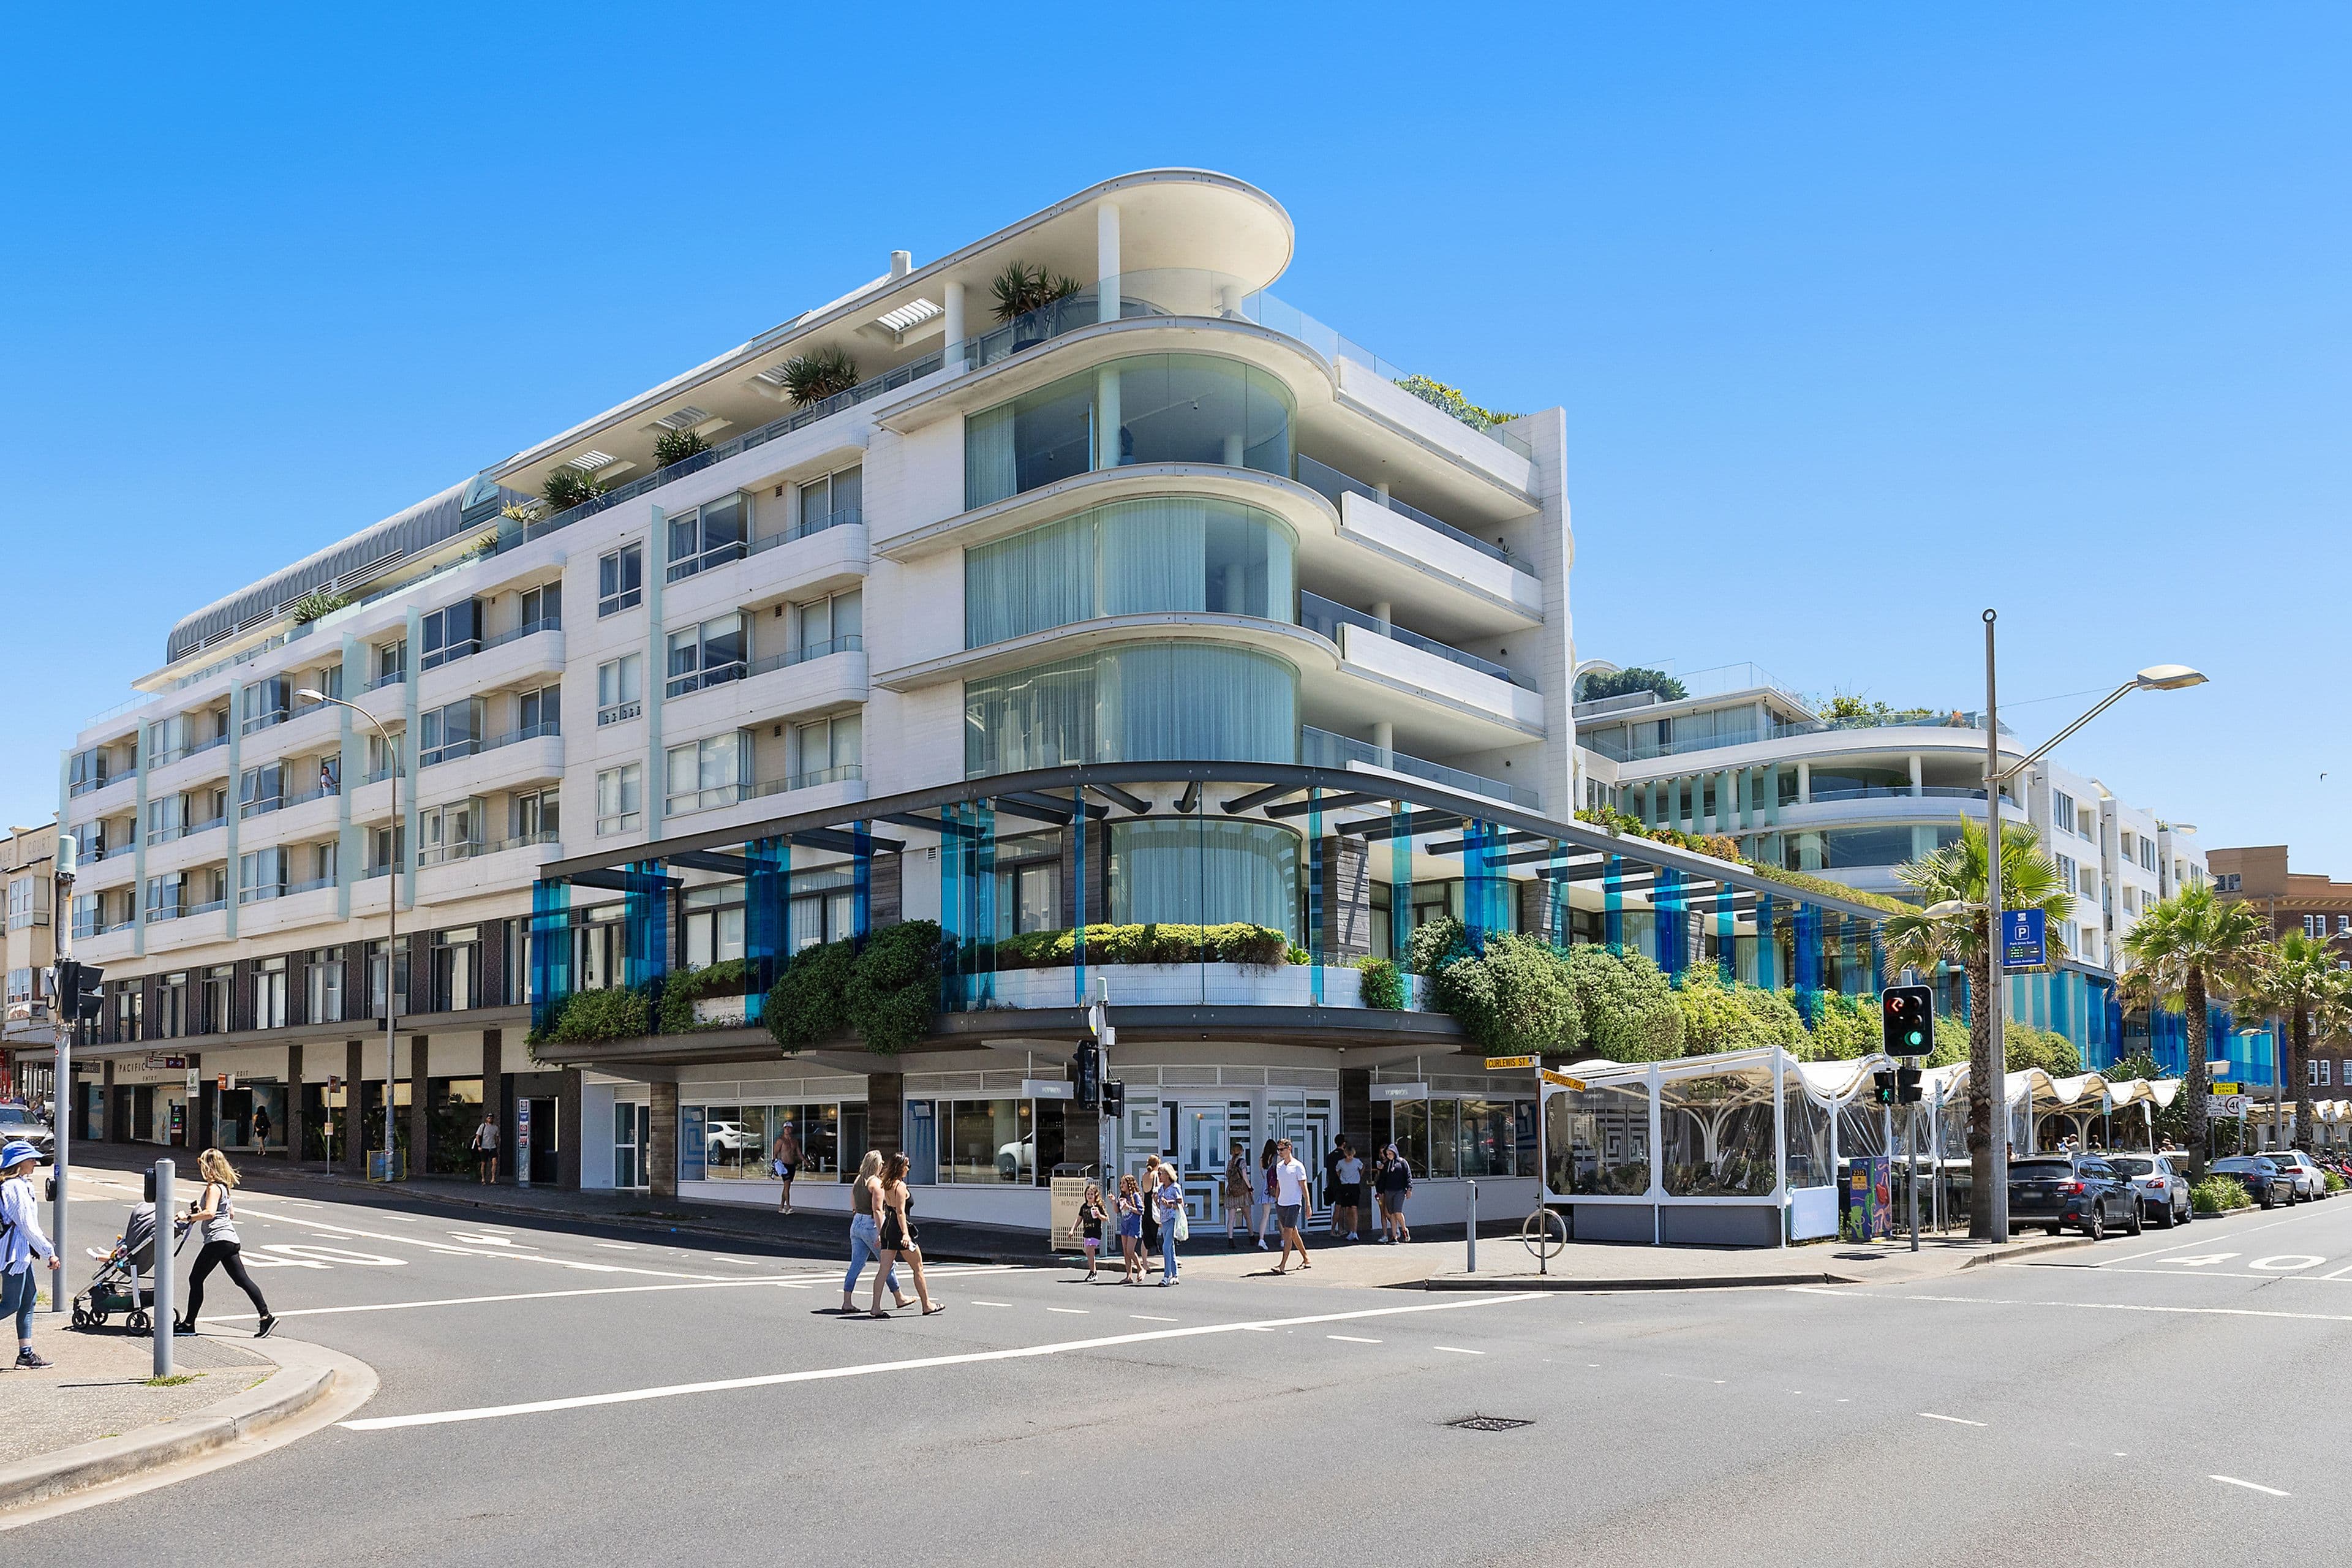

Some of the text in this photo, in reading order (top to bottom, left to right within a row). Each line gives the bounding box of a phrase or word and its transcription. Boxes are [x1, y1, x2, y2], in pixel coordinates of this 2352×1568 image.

[28, 835, 51, 854] COURT
[2018, 927, 2027, 938] P
[119, 1063, 145, 1072] PACIFIC
[1488, 1057, 1526, 1068] CURLEWIS ST
[1548, 1072, 1571, 1087] CAMPBELL
[2155, 1253, 2328, 1270] 40
